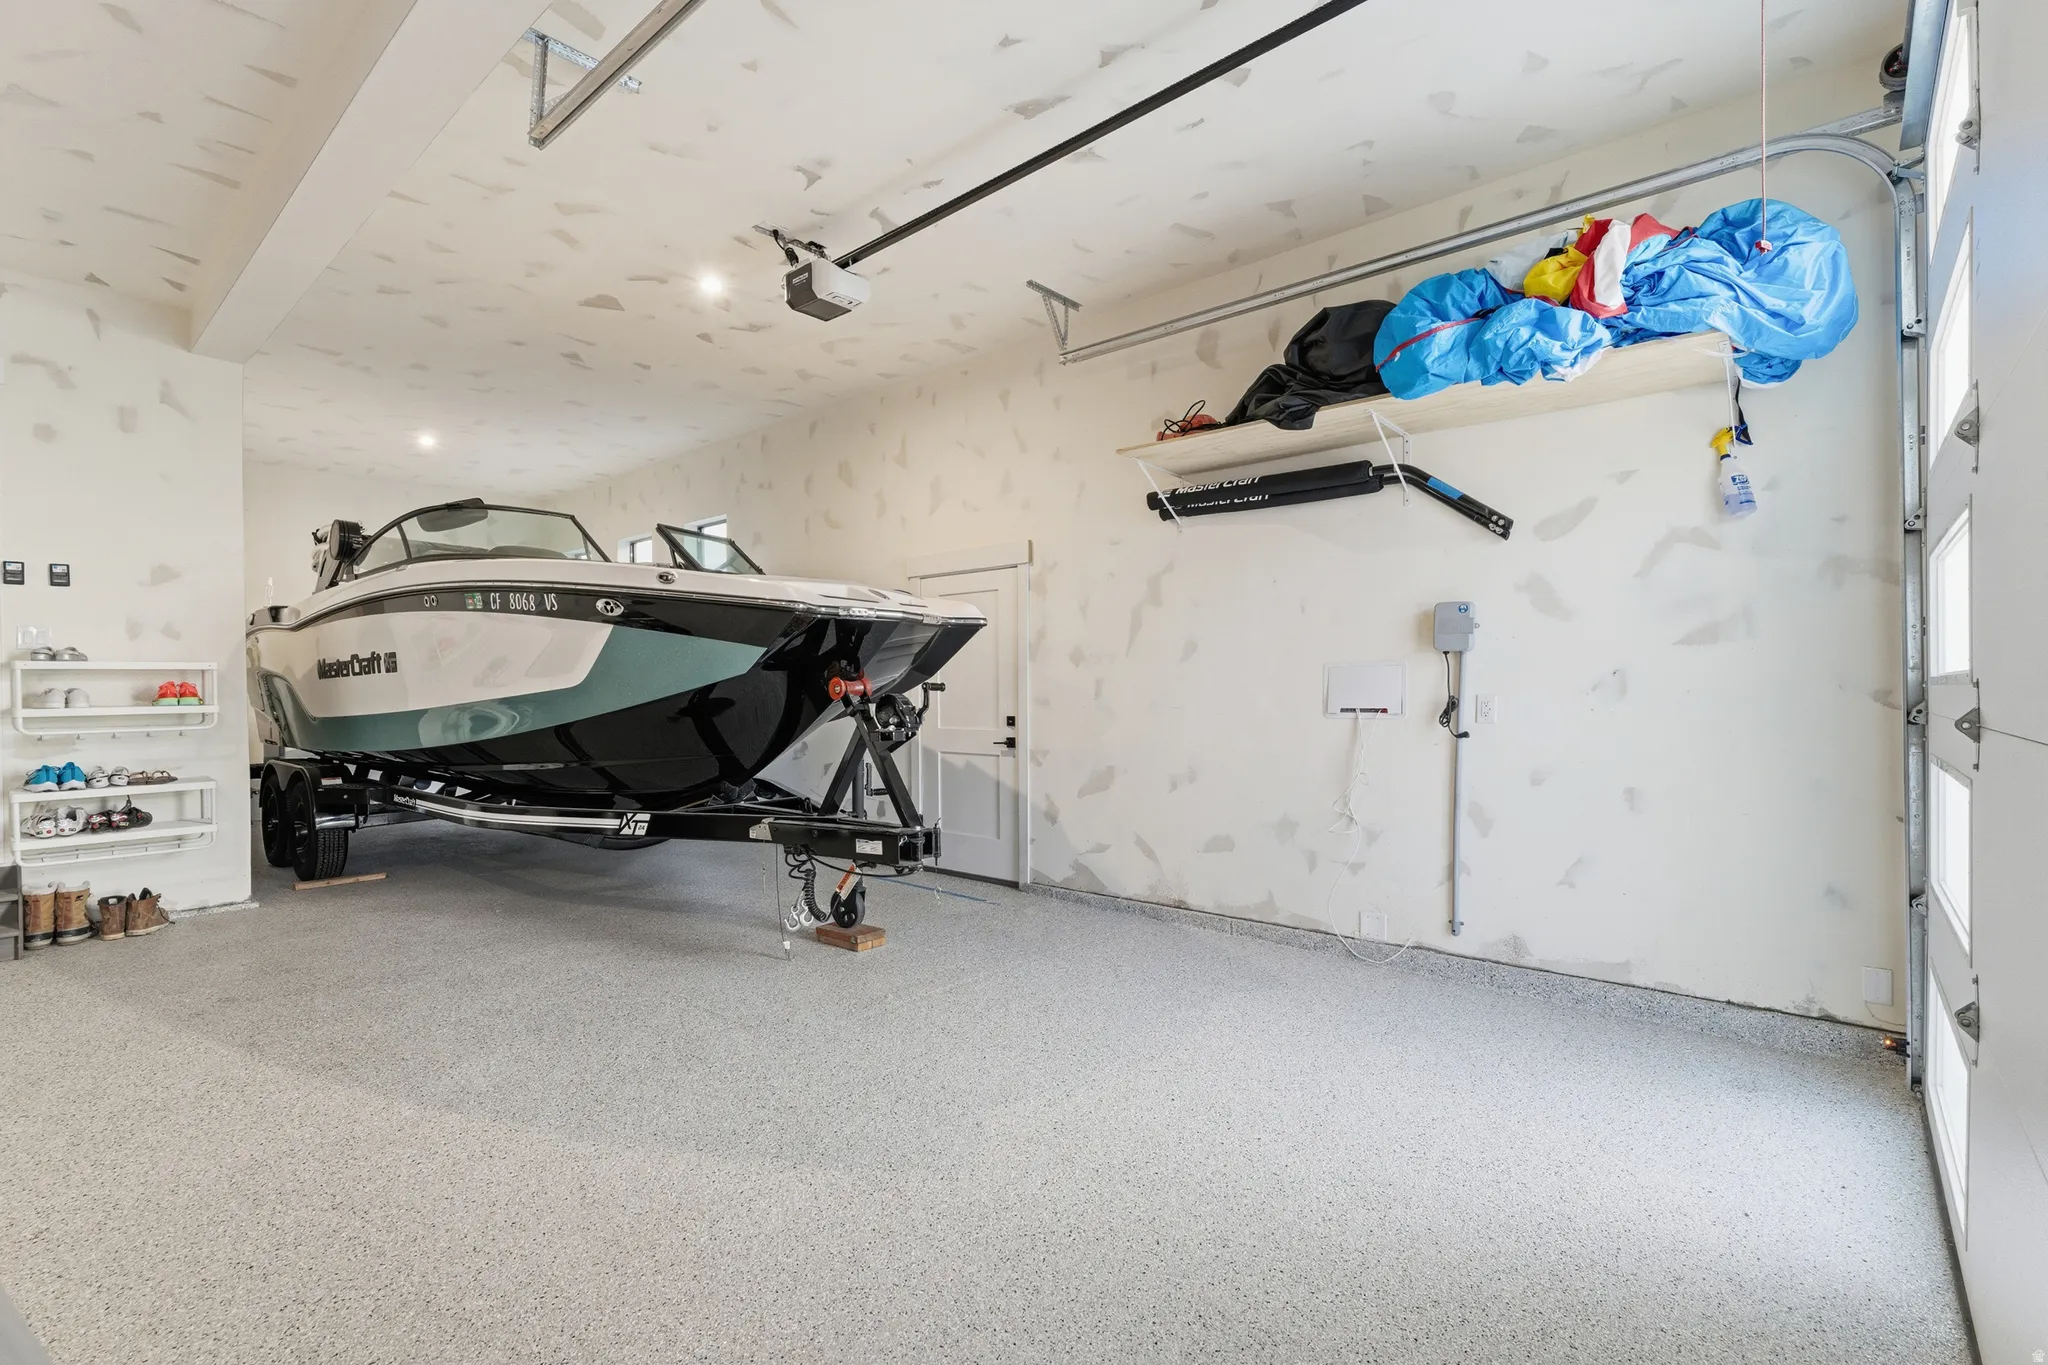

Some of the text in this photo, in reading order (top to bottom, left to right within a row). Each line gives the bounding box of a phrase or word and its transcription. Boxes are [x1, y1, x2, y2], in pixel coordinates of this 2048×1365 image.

[490, 592, 558, 611] CF 8068 VS
[317, 651, 382, 680] MasterCraft
[620, 812, 650, 835] XT
